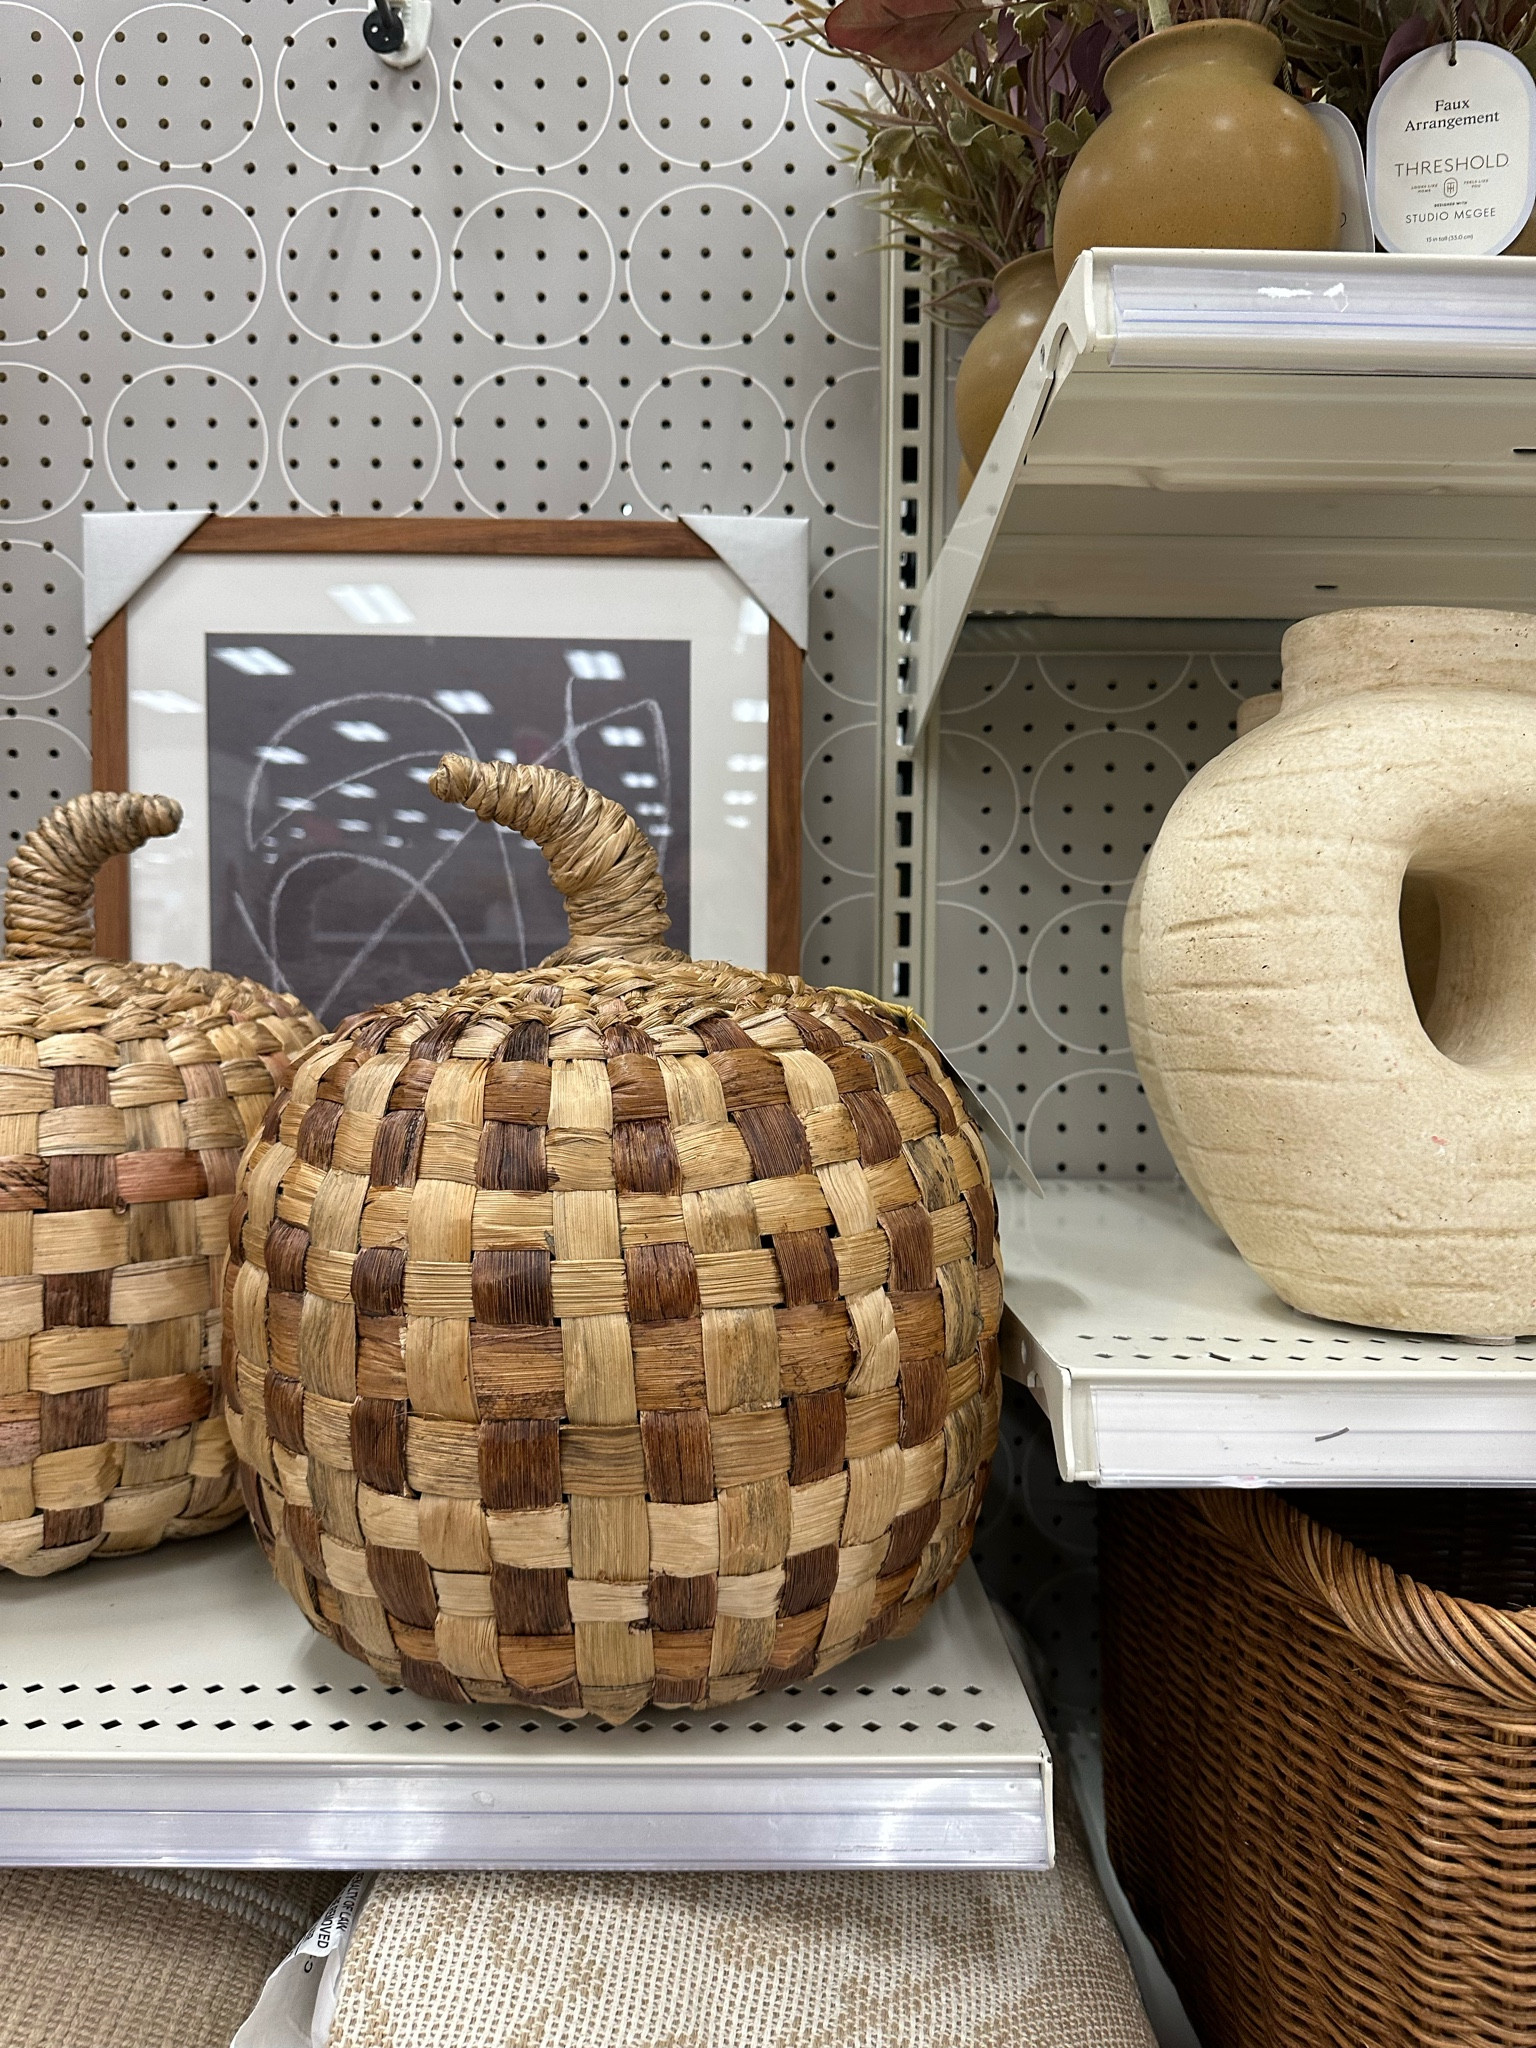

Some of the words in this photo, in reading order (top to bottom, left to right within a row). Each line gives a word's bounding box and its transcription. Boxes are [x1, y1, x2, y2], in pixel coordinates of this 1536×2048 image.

[1435, 99, 1470, 112] Faux
[1404, 111, 1500, 132] Arrangement
[1394, 153, 1509, 177] THRESHOLD
[1405, 211, 1449, 224] STUDIO
